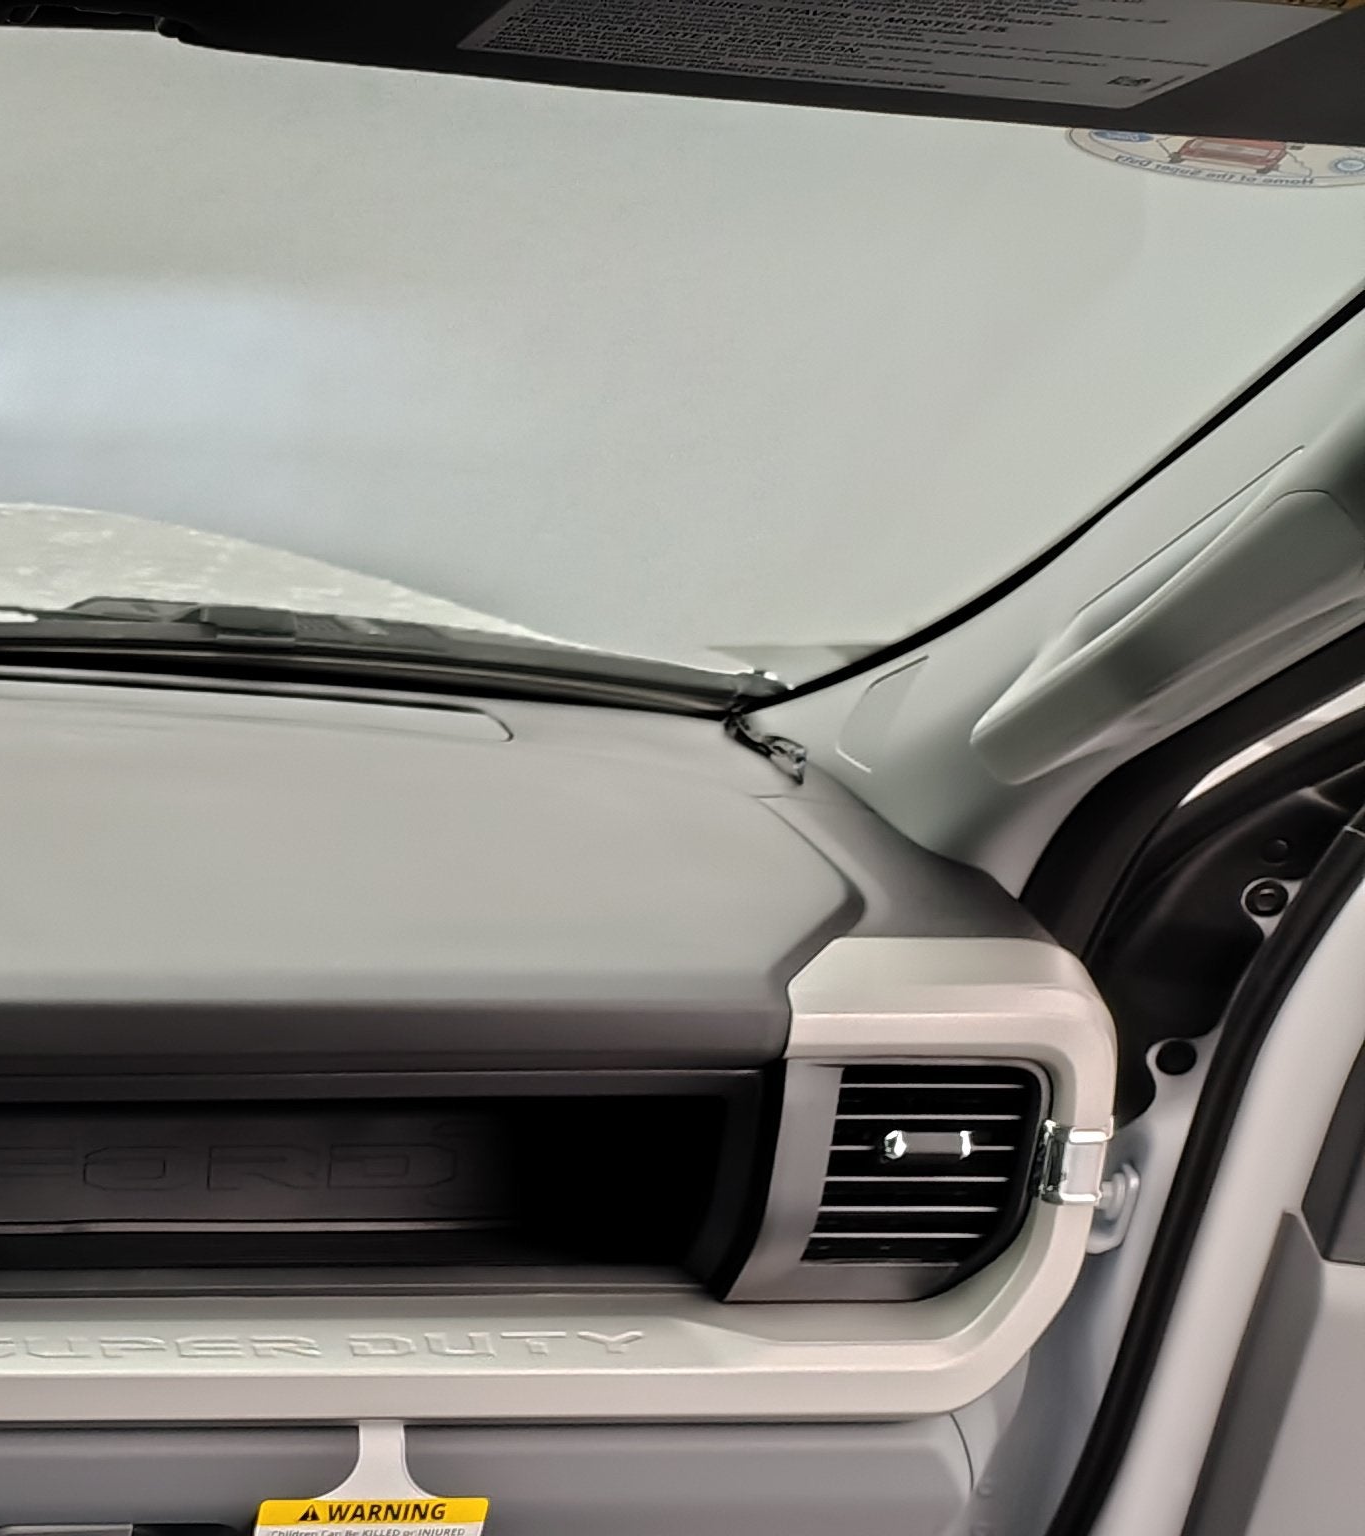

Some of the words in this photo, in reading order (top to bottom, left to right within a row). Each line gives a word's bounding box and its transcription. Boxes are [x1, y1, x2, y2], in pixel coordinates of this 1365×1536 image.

[347, 1328, 645, 1360] DUTY
[328, 1503, 446, 1521] WARNING
[418, 1528, 465, 1536] INJURED
